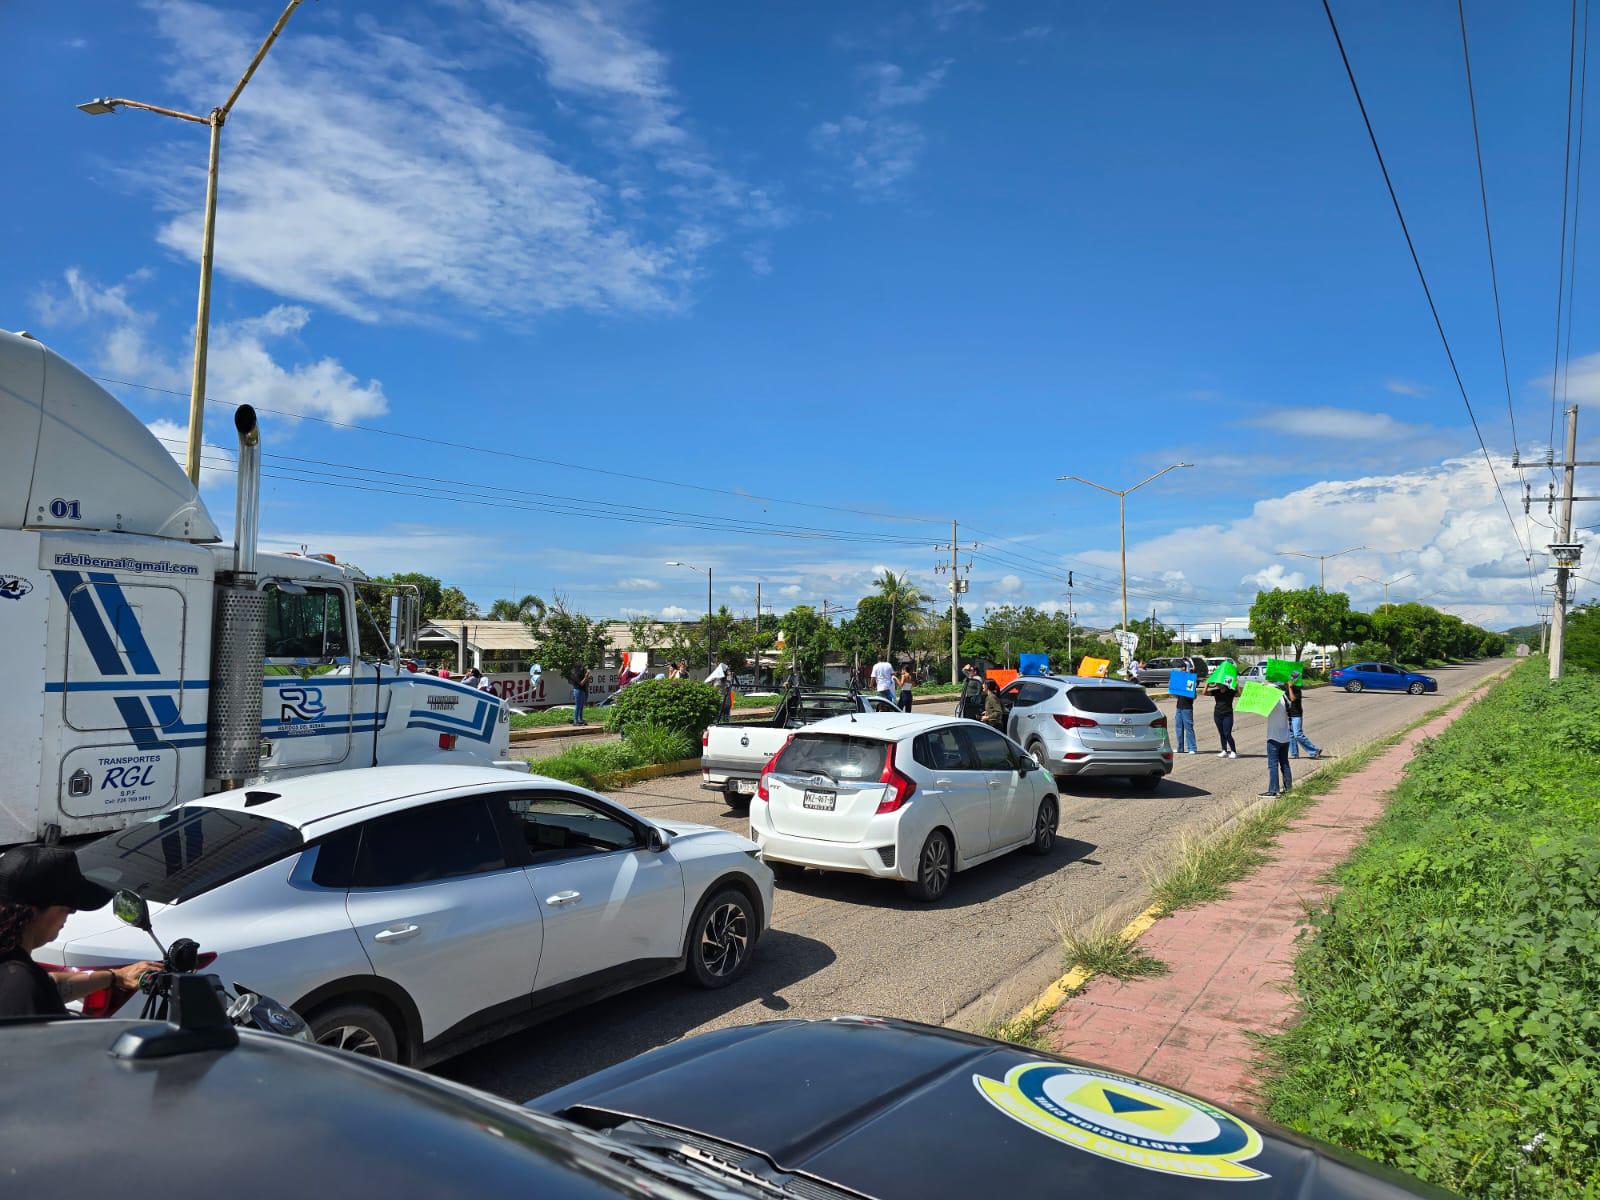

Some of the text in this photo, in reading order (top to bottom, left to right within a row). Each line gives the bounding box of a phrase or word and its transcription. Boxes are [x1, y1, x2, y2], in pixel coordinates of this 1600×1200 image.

[50, 498, 82, 520] 01
[55, 553, 199, 575] rdelbernal@gmail.com
[98, 755, 161, 766] TRANSPORTES
[101, 765, 155, 790] RGL
[1033, 1095, 1191, 1153] PROTECCION CIVIL
